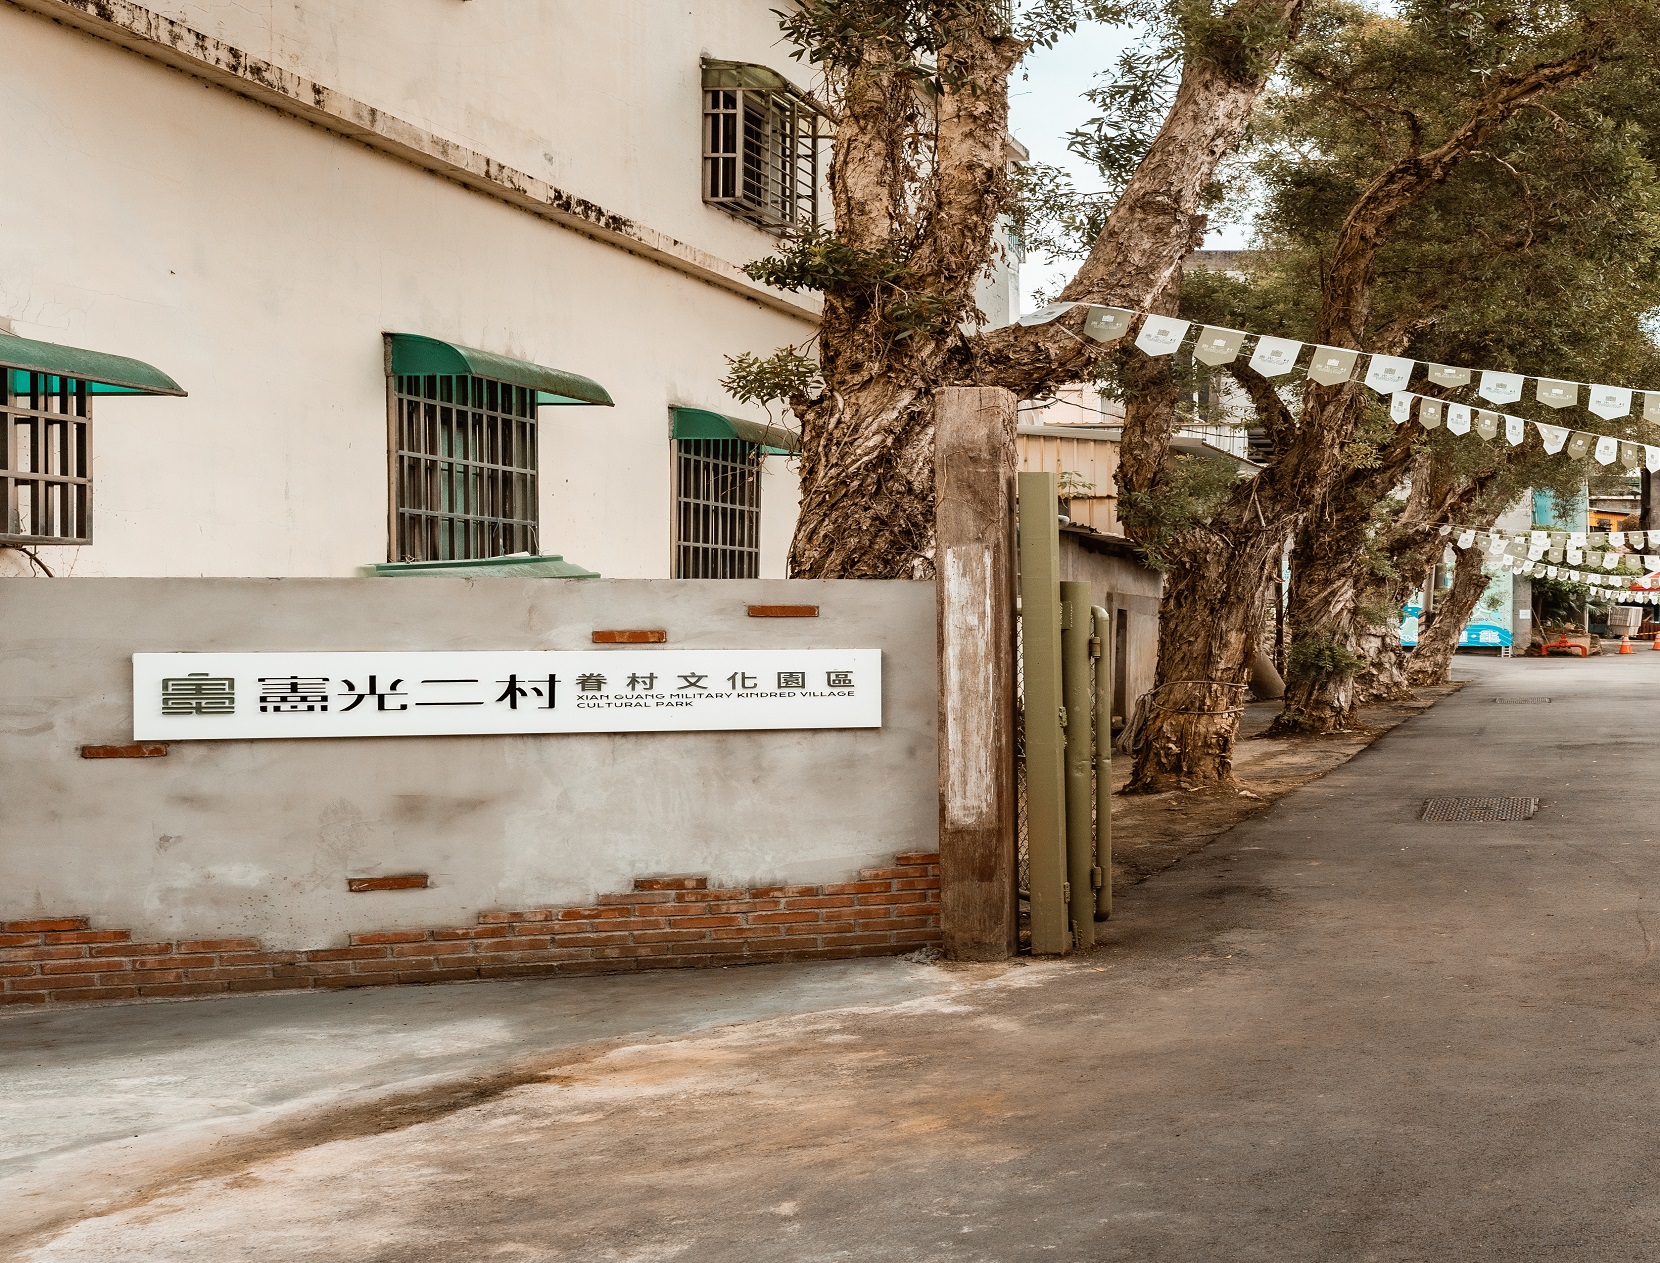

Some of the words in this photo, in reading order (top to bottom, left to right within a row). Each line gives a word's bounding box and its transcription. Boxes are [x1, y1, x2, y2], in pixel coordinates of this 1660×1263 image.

[575, 671, 855, 692] 眷村文化園區
[257, 674, 562, 713] 憲光二村
[669, 692, 733, 700] MILITARY
[737, 691, 797, 699] KINDRED
